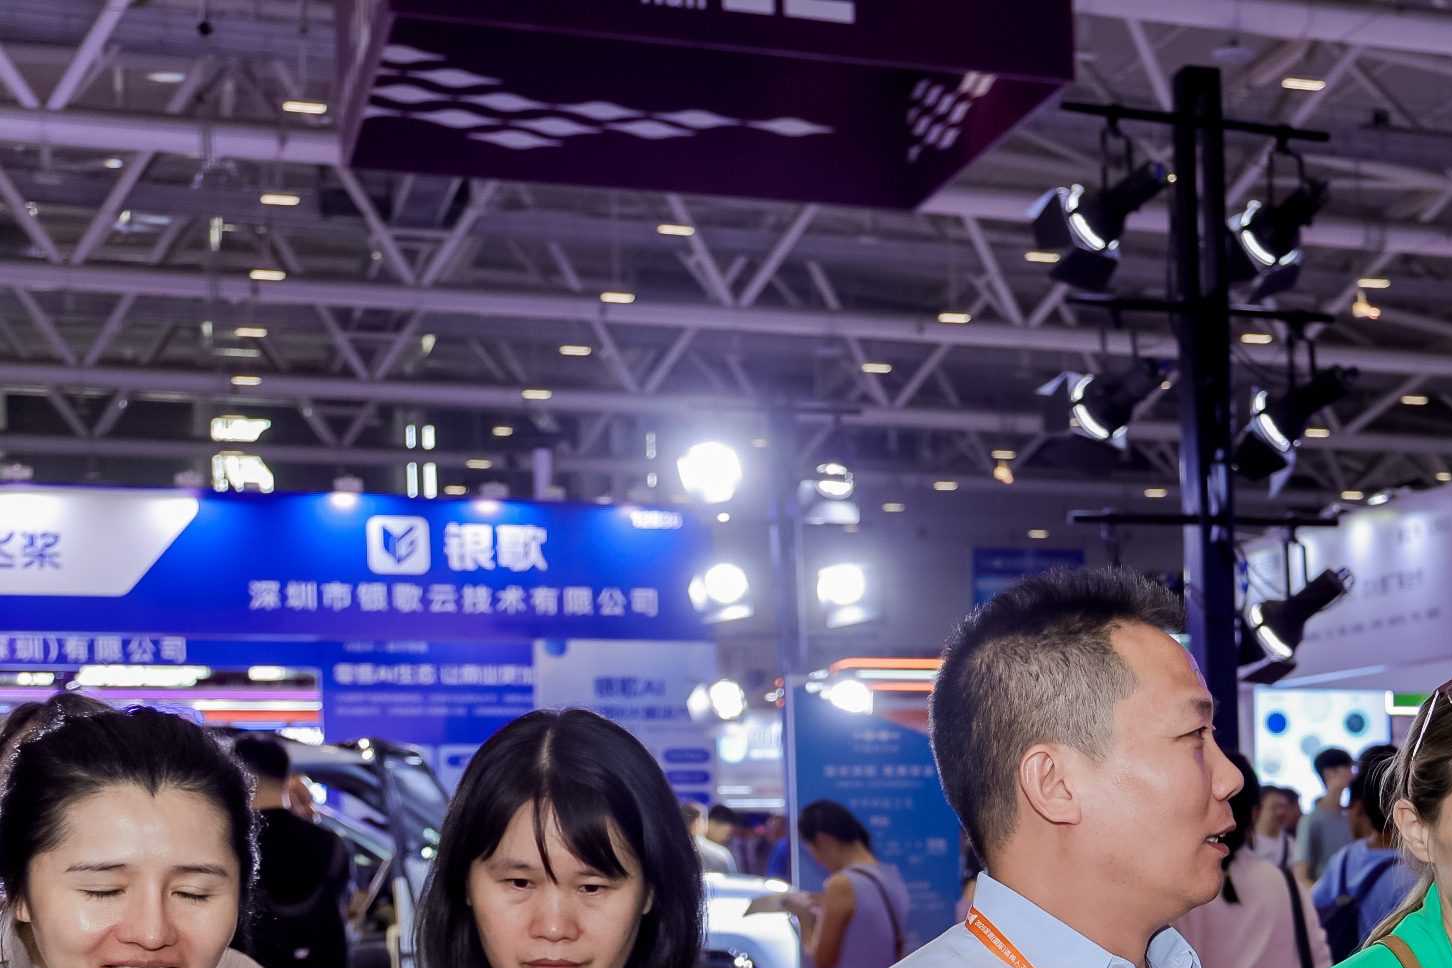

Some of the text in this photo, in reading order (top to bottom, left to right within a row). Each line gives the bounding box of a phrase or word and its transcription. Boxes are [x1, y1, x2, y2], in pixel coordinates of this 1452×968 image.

[444, 522, 548, 572] 银歌
[248, 580, 659, 617] 深圳市银歌云技术有限公司
